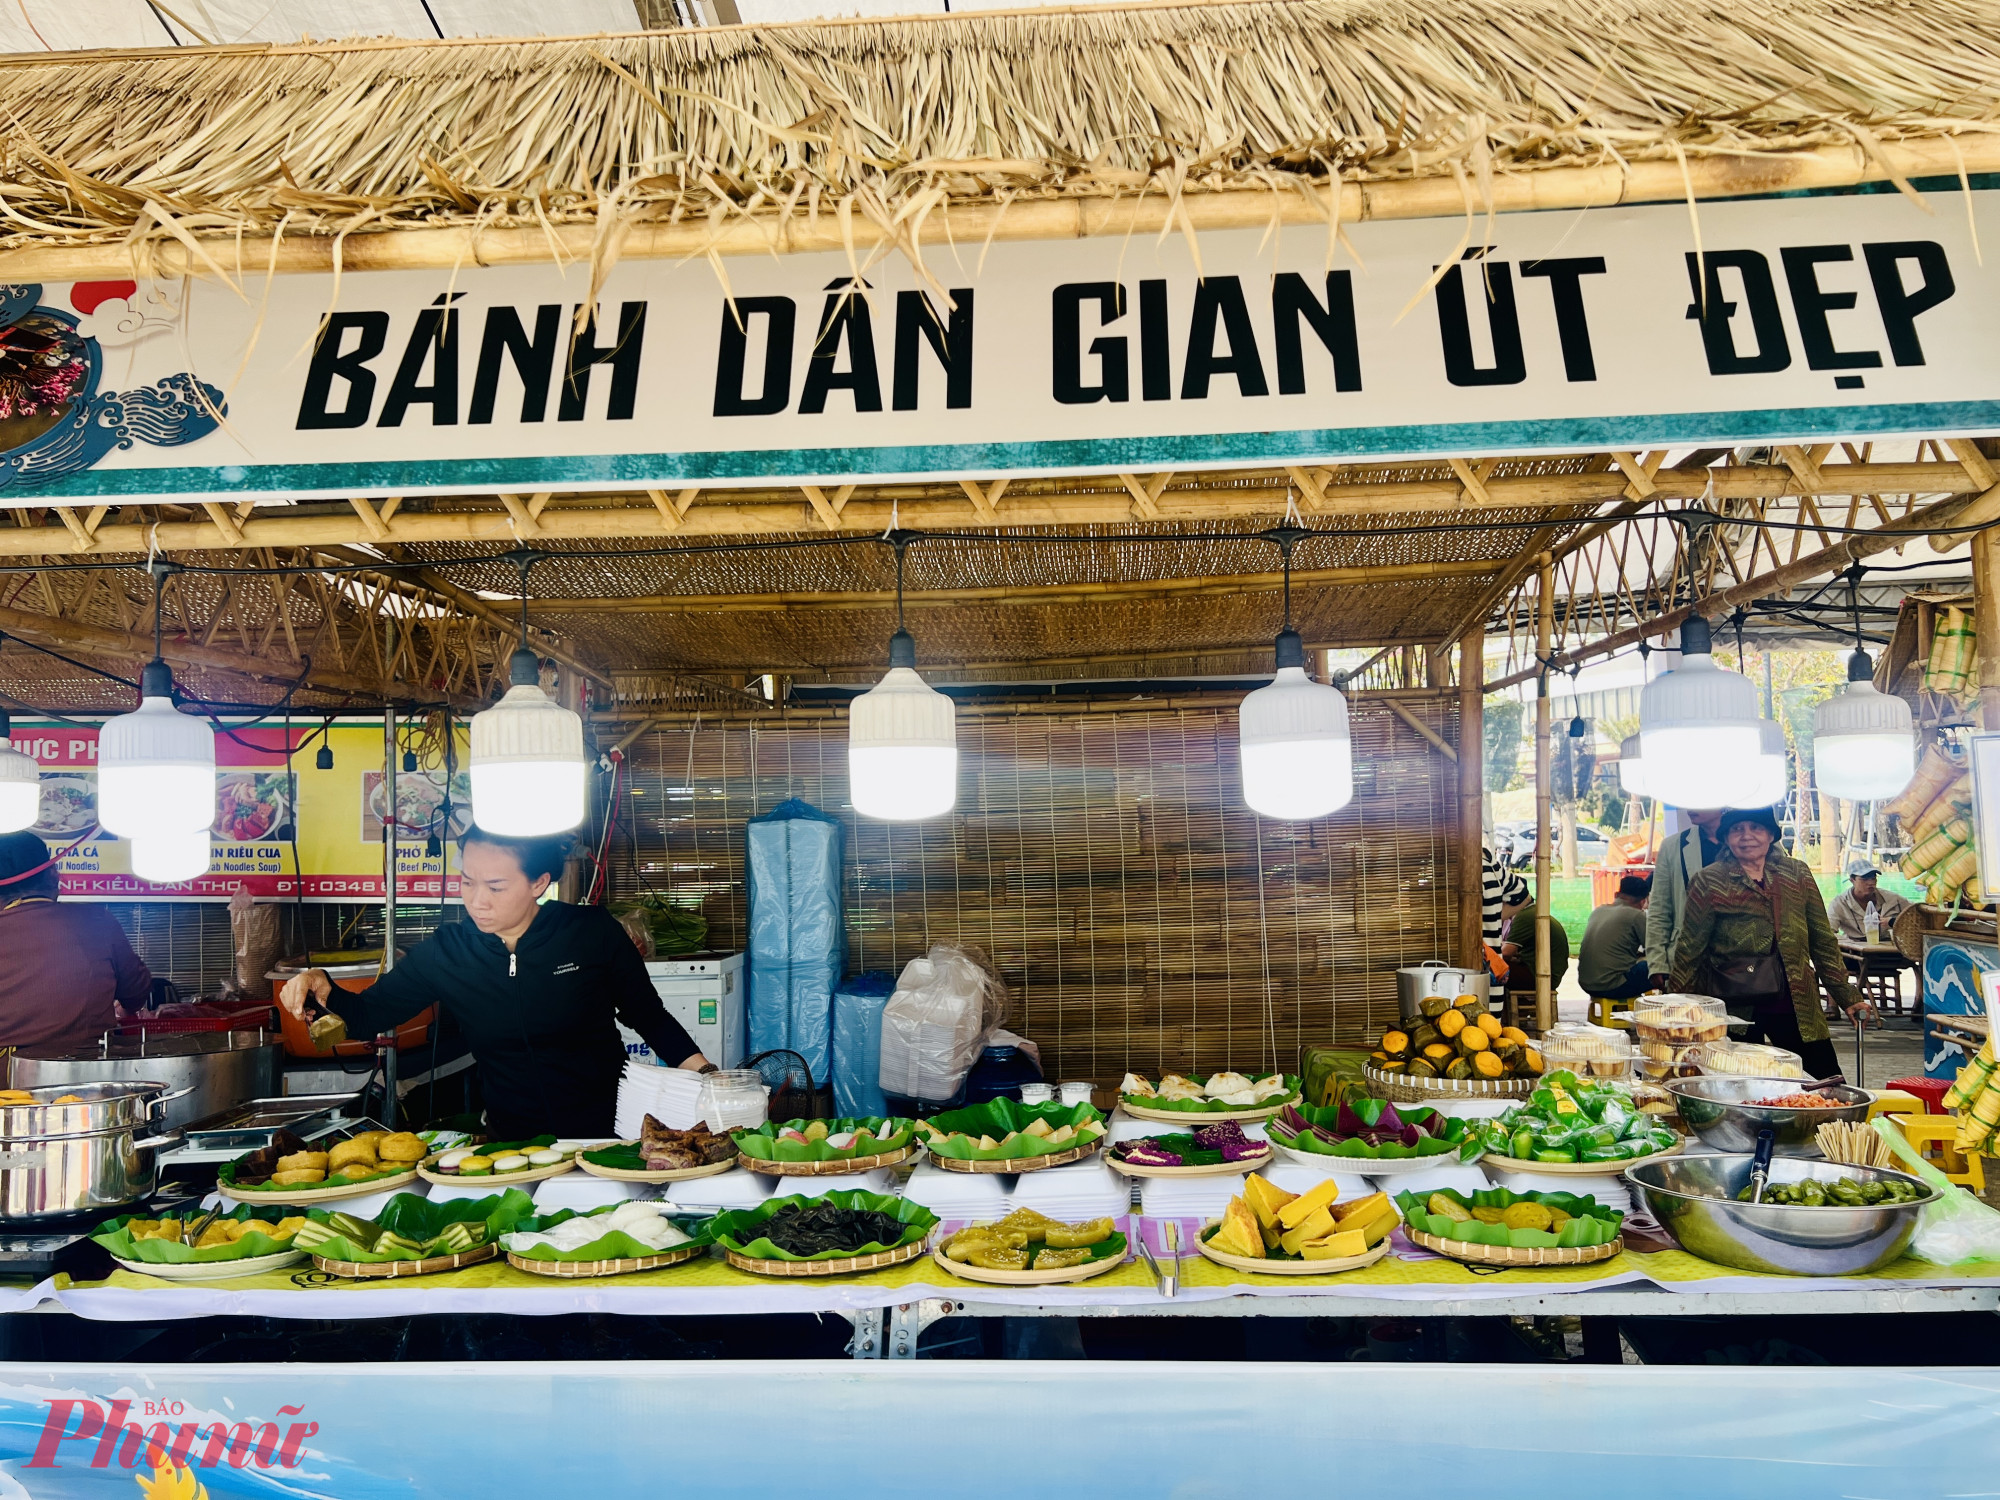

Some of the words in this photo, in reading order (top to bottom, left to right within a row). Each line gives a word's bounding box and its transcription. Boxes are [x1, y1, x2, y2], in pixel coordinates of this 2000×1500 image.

[296, 291, 648, 430] BÁNH
[713, 276, 974, 417] DÂN
[1051, 268, 1363, 405] GIAN
[1432, 244, 1607, 388] ÚT
[1685, 239, 1956, 391] ĐẸP
[69, 739, 99, 760] PH
[82, 845, 99, 858] CÁ
[256, 847, 281, 858] CUA
[224, 862, 255, 872] Noodles
[258, 862, 281, 874] Soup)
[397, 861, 419, 873] (Beef
[422, 861, 441, 873] Pho)
[198, 879, 242, 891] THƠ
[320, 881, 375, 892] 0348
